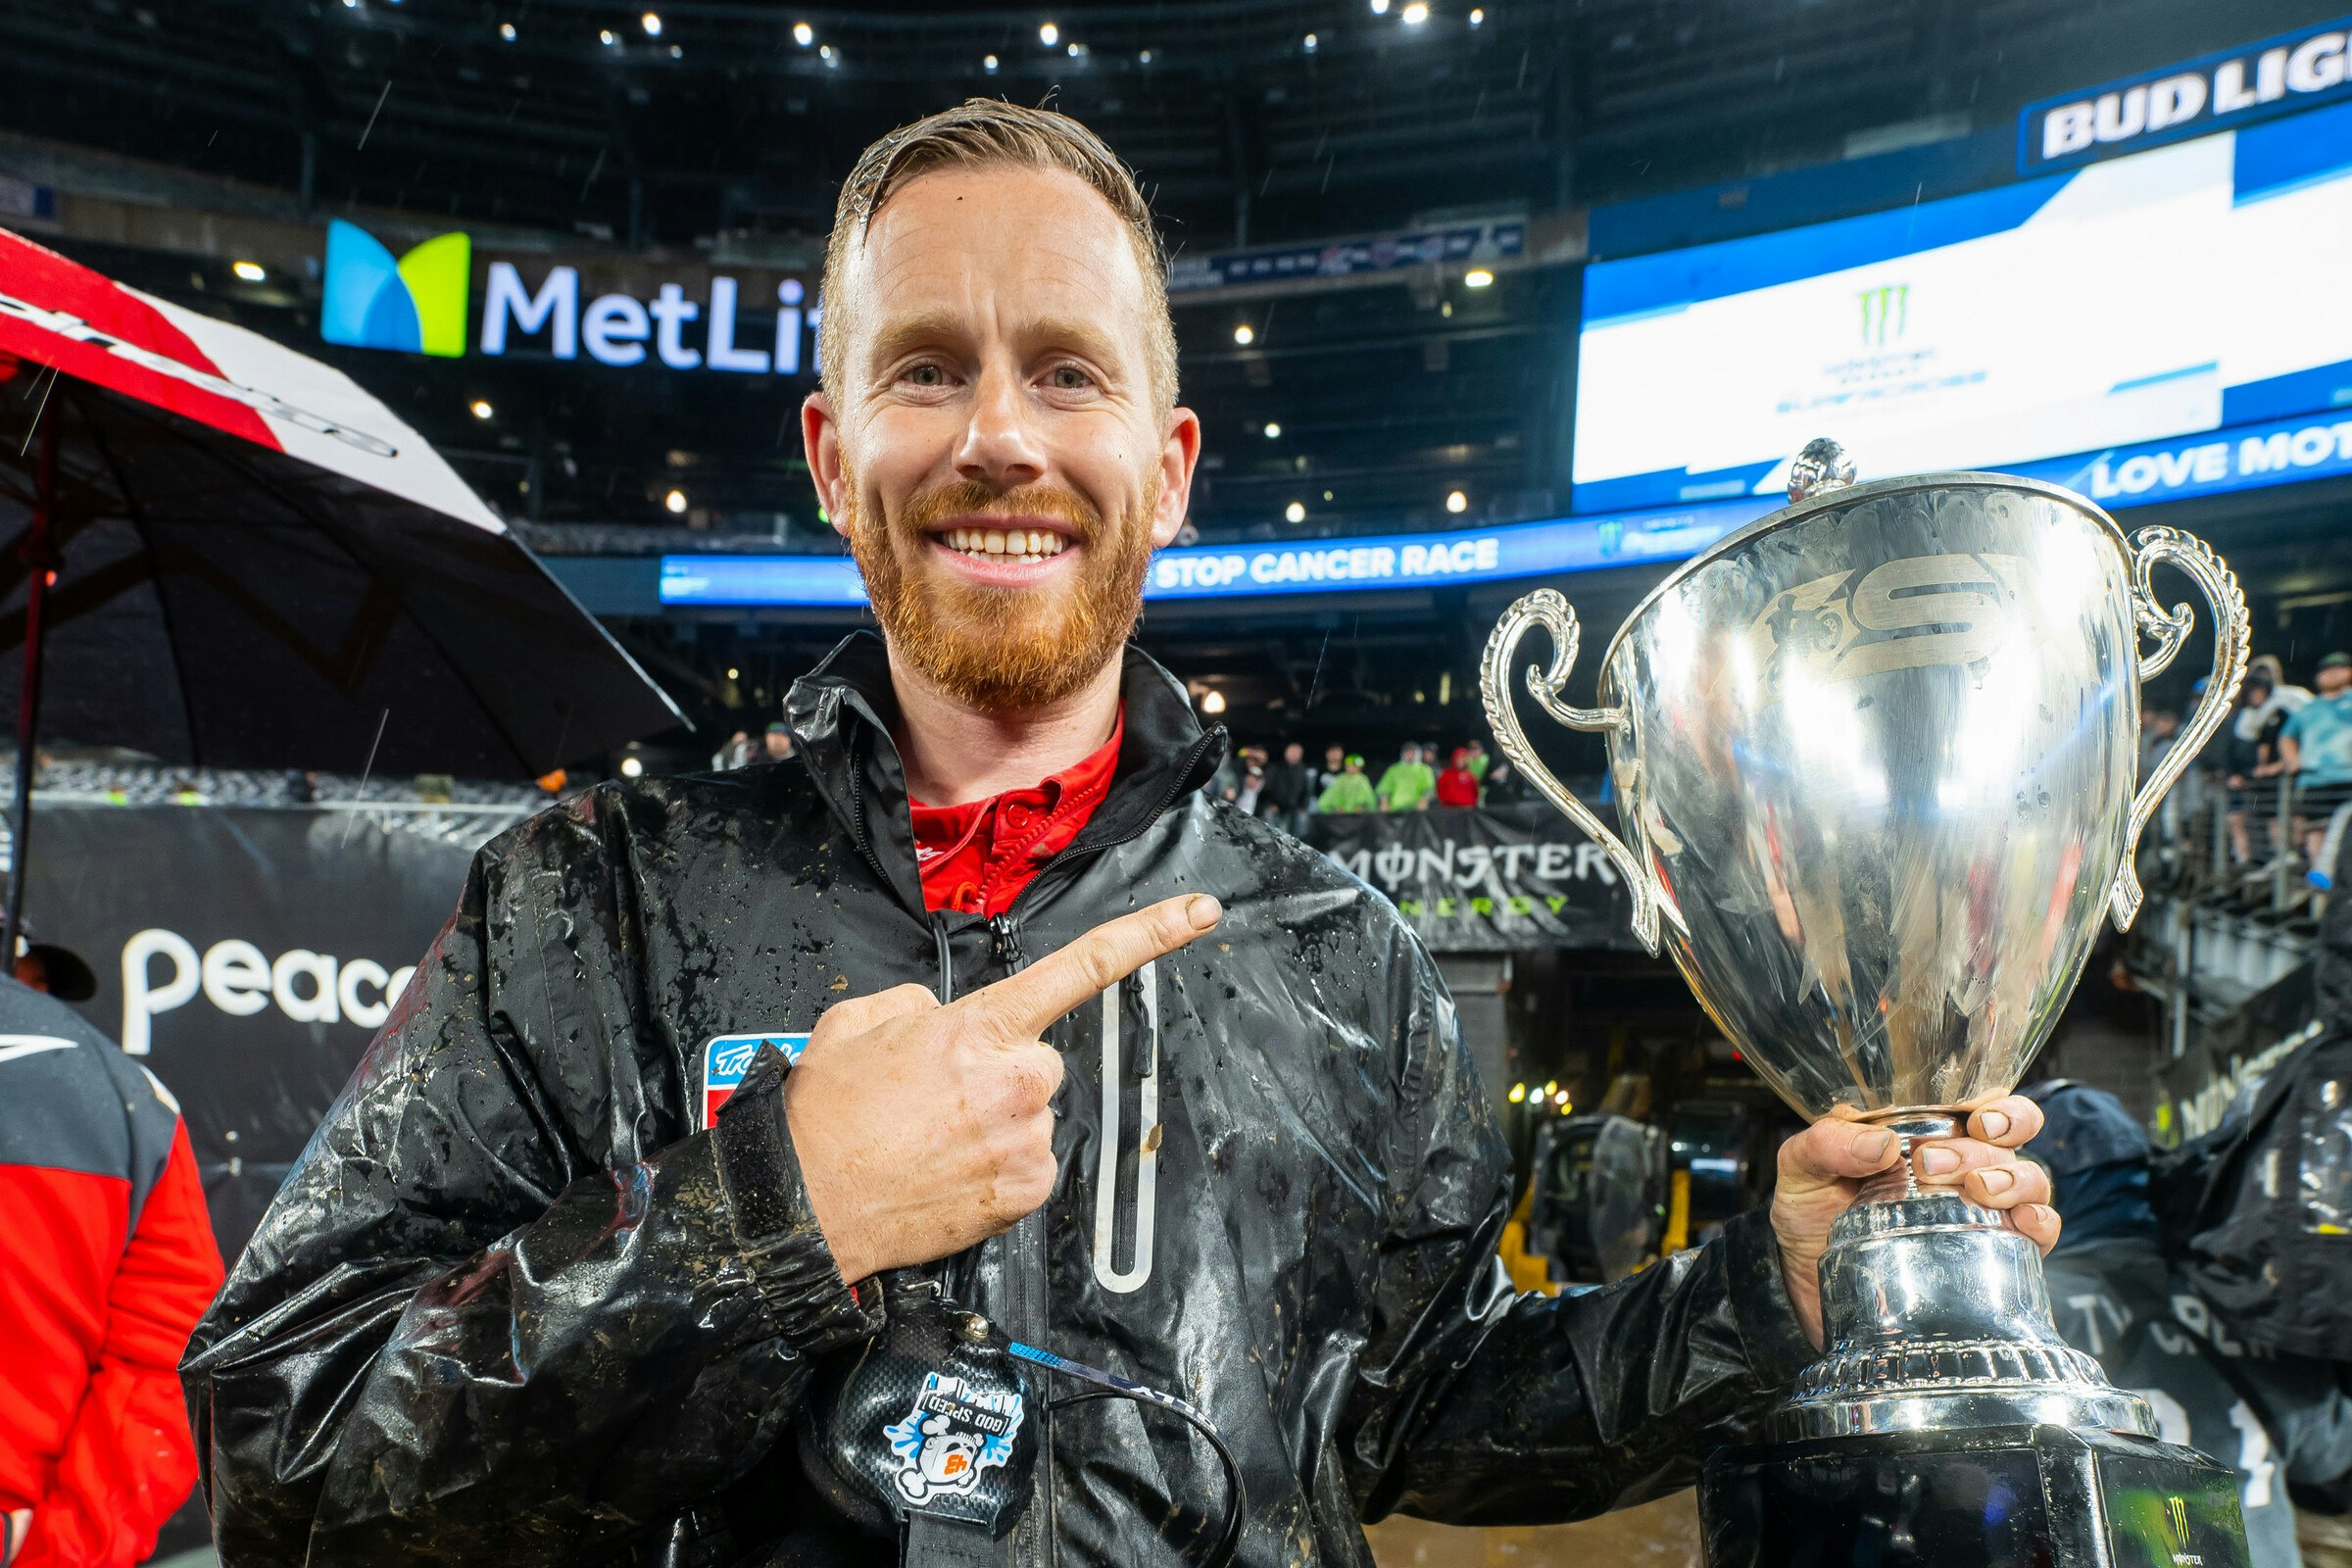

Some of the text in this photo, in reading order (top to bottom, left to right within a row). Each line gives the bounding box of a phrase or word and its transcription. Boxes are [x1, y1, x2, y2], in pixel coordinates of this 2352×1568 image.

[2042, 29, 2352, 160] BUD LIG
[2091, 442, 2230, 499] LOVE
[1155, 538, 1499, 588] STOP CANCER RACE
[944, 1454, 967, 1475] 43
